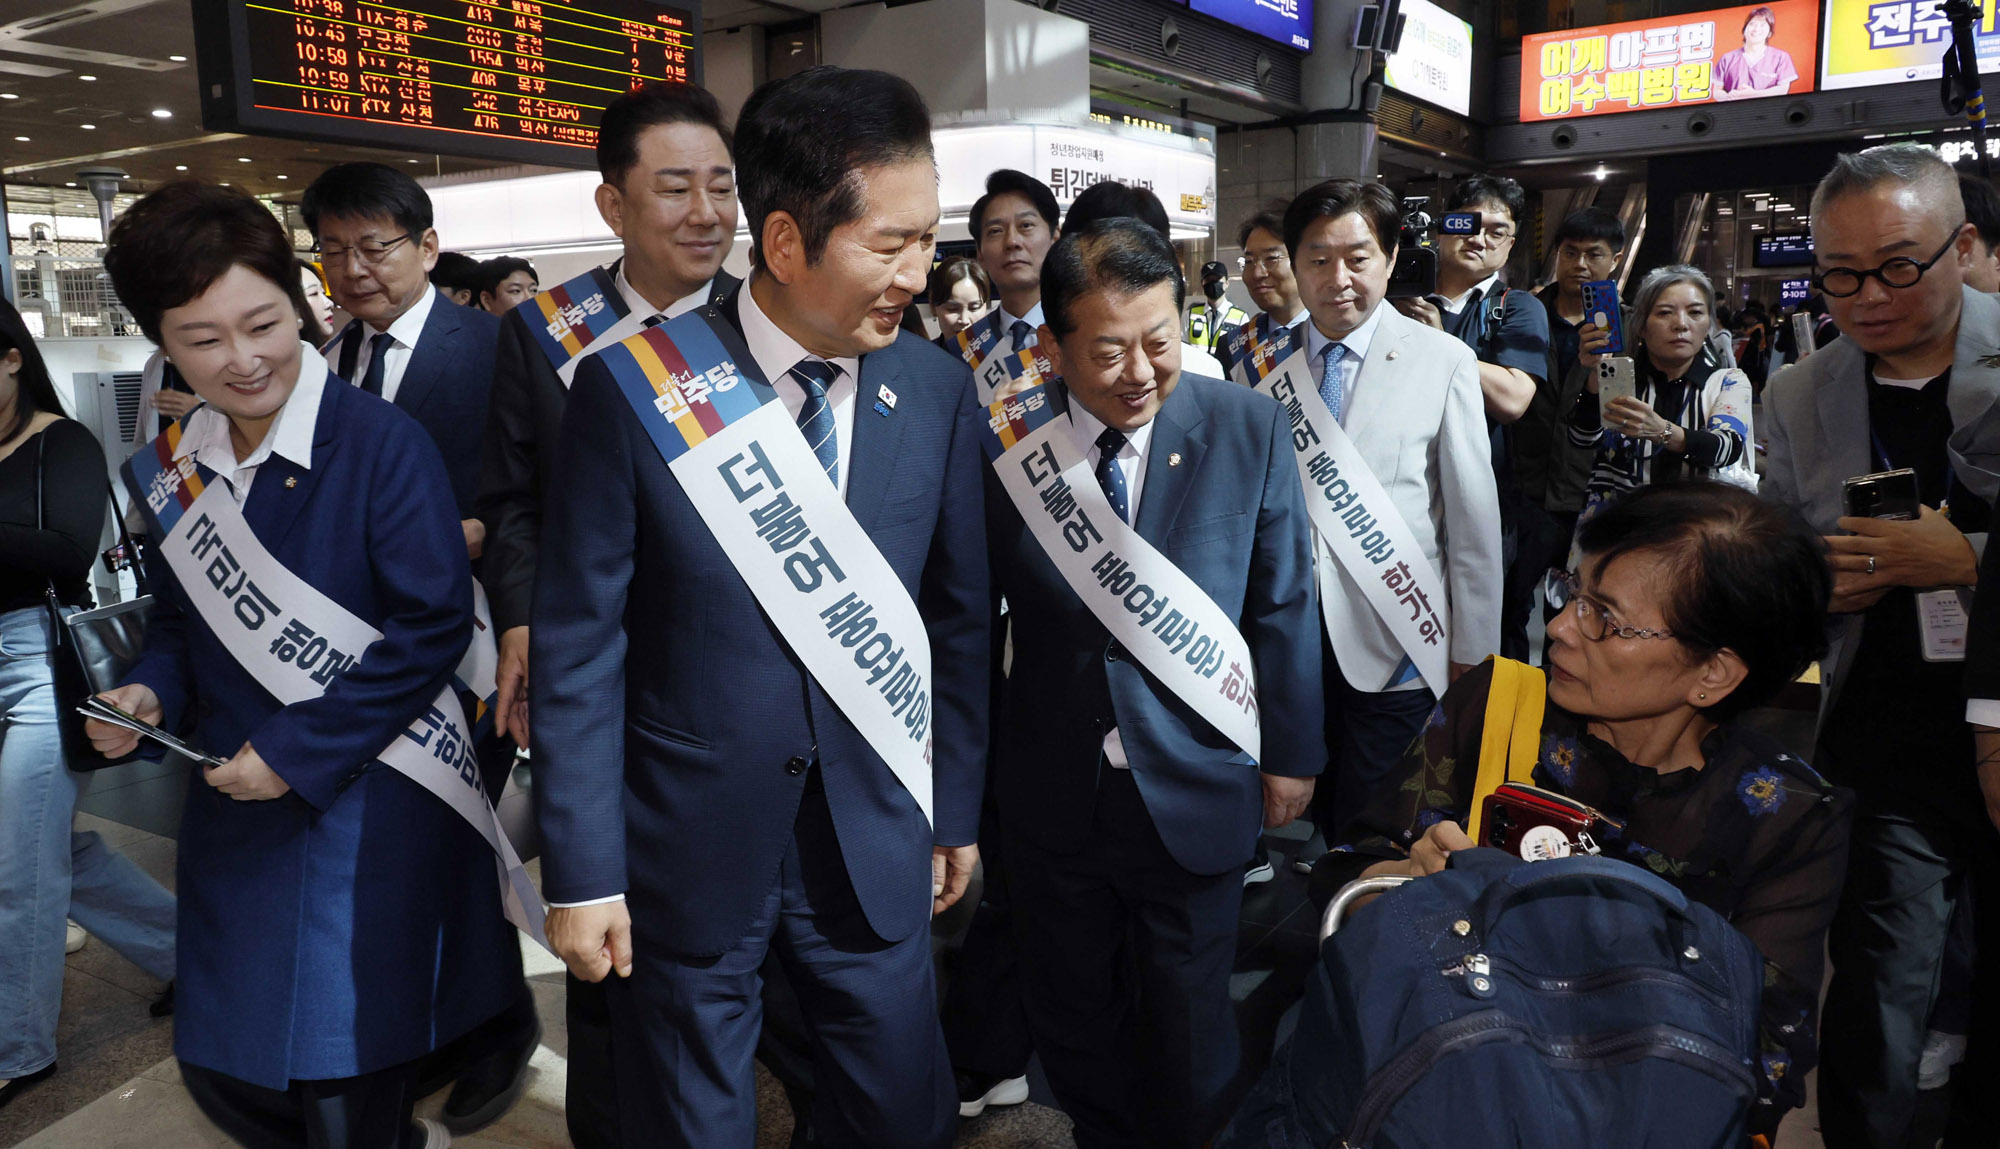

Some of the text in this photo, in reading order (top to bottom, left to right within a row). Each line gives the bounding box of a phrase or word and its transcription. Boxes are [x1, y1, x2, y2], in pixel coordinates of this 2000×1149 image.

[296, 41, 347, 66] 10:59
[1541, 21, 1715, 78] 어깨 아프면
[298, 65, 350, 90] 10:59
[1540, 62, 1712, 115] 여수백병원
[301, 89, 351, 113] 11:07
[361, 96, 391, 115] KTX
[400, 102, 433, 125] 산천
[1445, 218, 1472, 230] CBS
[546, 292, 605, 343] 민주당
[1228, 326, 1259, 355] 민주당
[961, 328, 992, 363] 민주당
[1251, 334, 1291, 369] 민주당
[653, 361, 739, 424] 민주당
[659, 369, 692, 393] 더불어
[988, 392, 1046, 435] 민주당
[145, 453, 198, 516] 민주당
[186, 512, 283, 631] 국민의
[1020, 440, 1104, 553] 더불어
[1091, 550, 1225, 679] 풍요로운
[1306, 450, 1396, 565] 풍요로운
[1381, 560, 1445, 646] 한가위
[716, 439, 932, 744] 더불어 풍요로운
